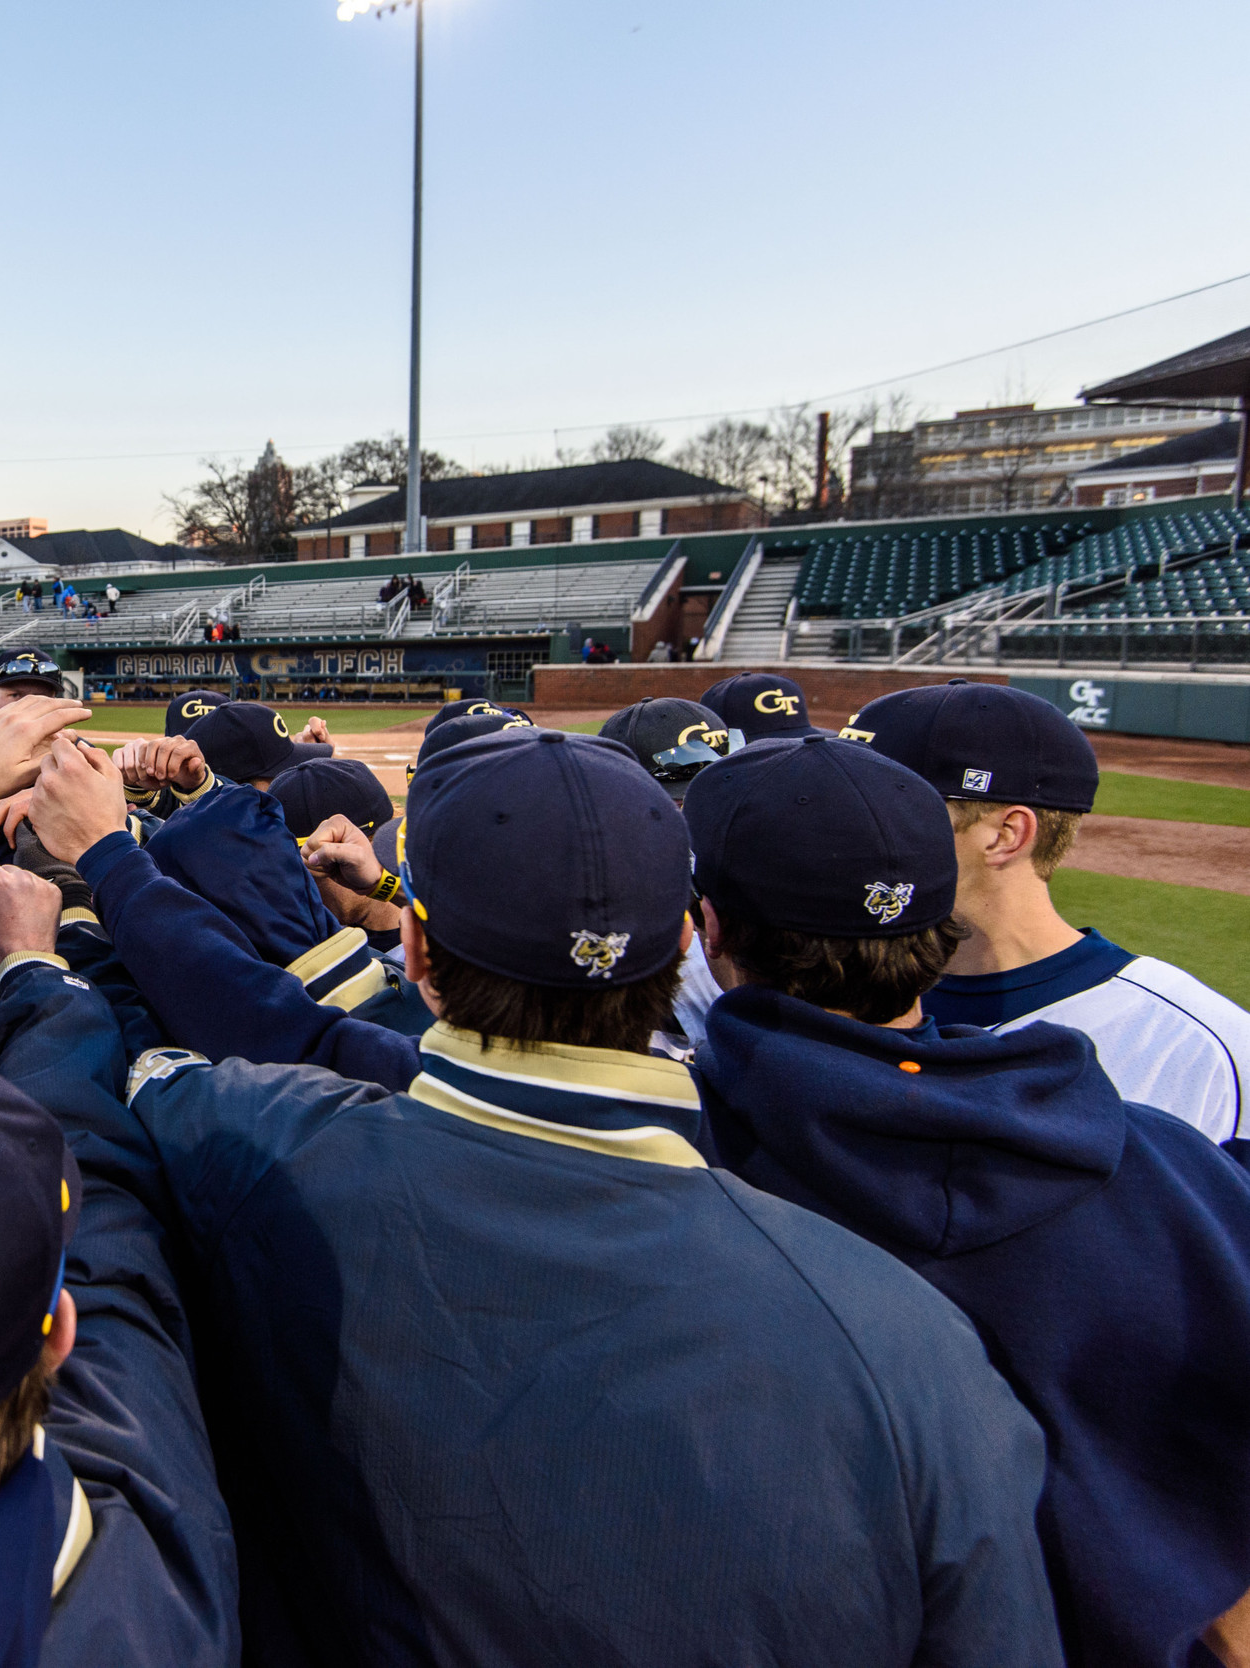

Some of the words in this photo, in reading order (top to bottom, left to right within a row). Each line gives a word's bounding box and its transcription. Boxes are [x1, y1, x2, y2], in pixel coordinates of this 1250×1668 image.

[116, 653, 239, 676] GEORGIA
[313, 649, 405, 675] TECH
[754, 688, 800, 715] GT
[1069, 680, 1105, 706] GT
[1067, 706, 1111, 725] ACC
